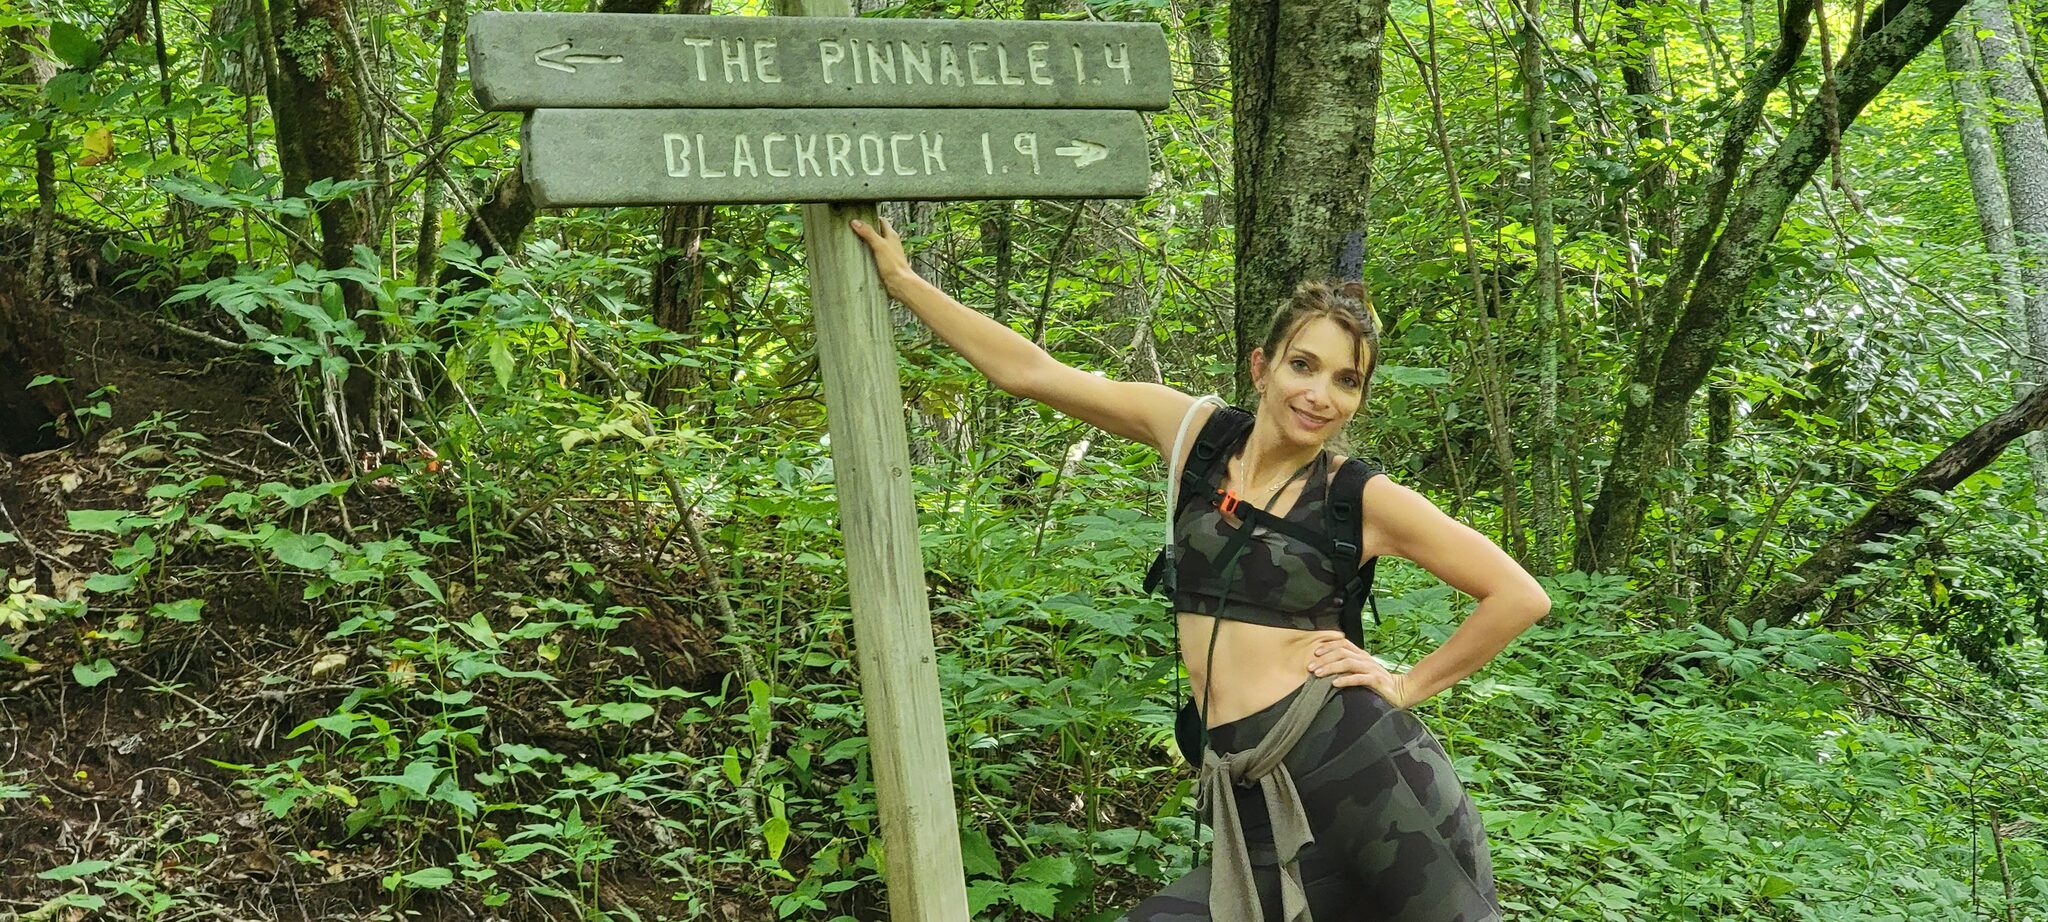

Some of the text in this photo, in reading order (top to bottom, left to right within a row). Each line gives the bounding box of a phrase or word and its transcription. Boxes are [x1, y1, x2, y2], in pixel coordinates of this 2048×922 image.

[683, 36, 1133, 88] THE PINNACLE 1.4
[662, 131, 1041, 180] BLACKROCK 1.9
